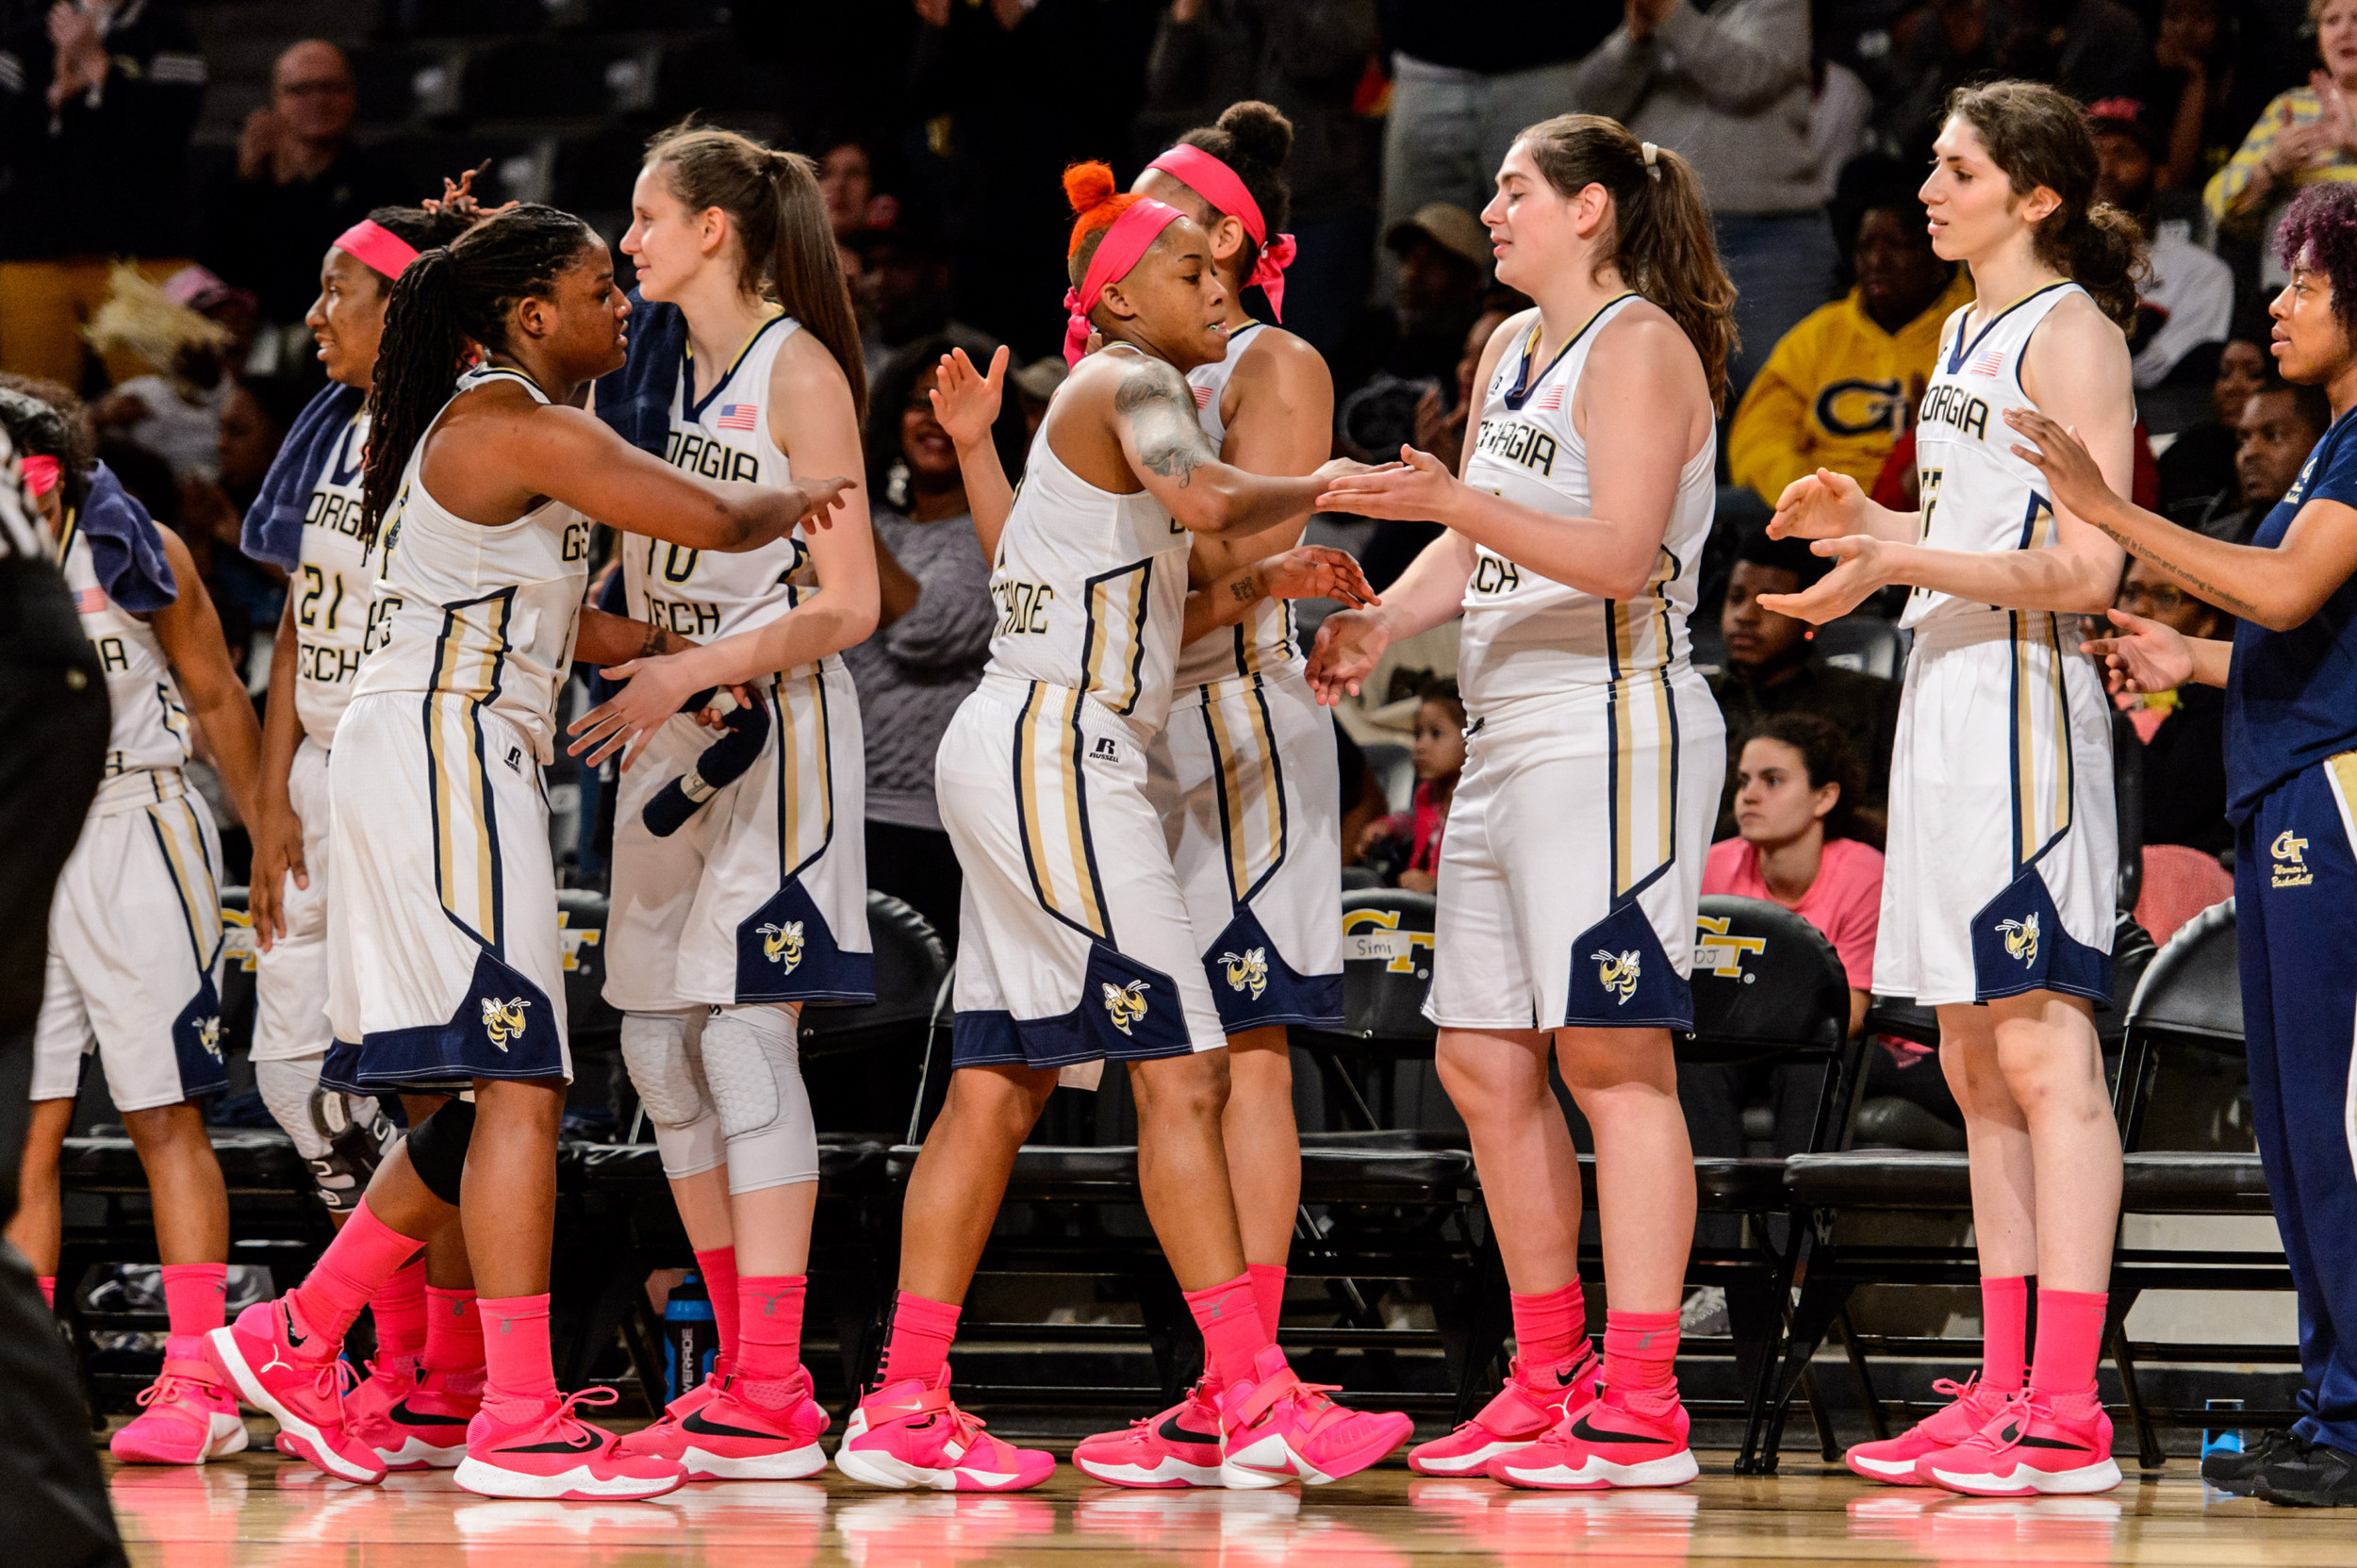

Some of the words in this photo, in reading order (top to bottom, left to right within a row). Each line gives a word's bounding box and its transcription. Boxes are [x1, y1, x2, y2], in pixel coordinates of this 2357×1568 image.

[1920, 385, 1989, 440] ORGIA
[668, 432, 760, 484] ORGIA
[303, 491, 362, 536] ORG
[1471, 556, 1520, 594] CH
[2138, 543, 2163, 566] known
[2162, 560, 2178, 573] and
[2177, 569, 2206, 590] nothing
[300, 565, 344, 630] 21
[301, 644, 361, 685] ECH
[1089, 752, 1120, 764] RUSSELL
[2270, 830, 2309, 863] GT
[2271, 873, 2314, 888] Basketball
[1358, 938, 1392, 956] Simi
[1694, 949, 1720, 965] DJ
[681, 1327, 694, 1394] WERADE
